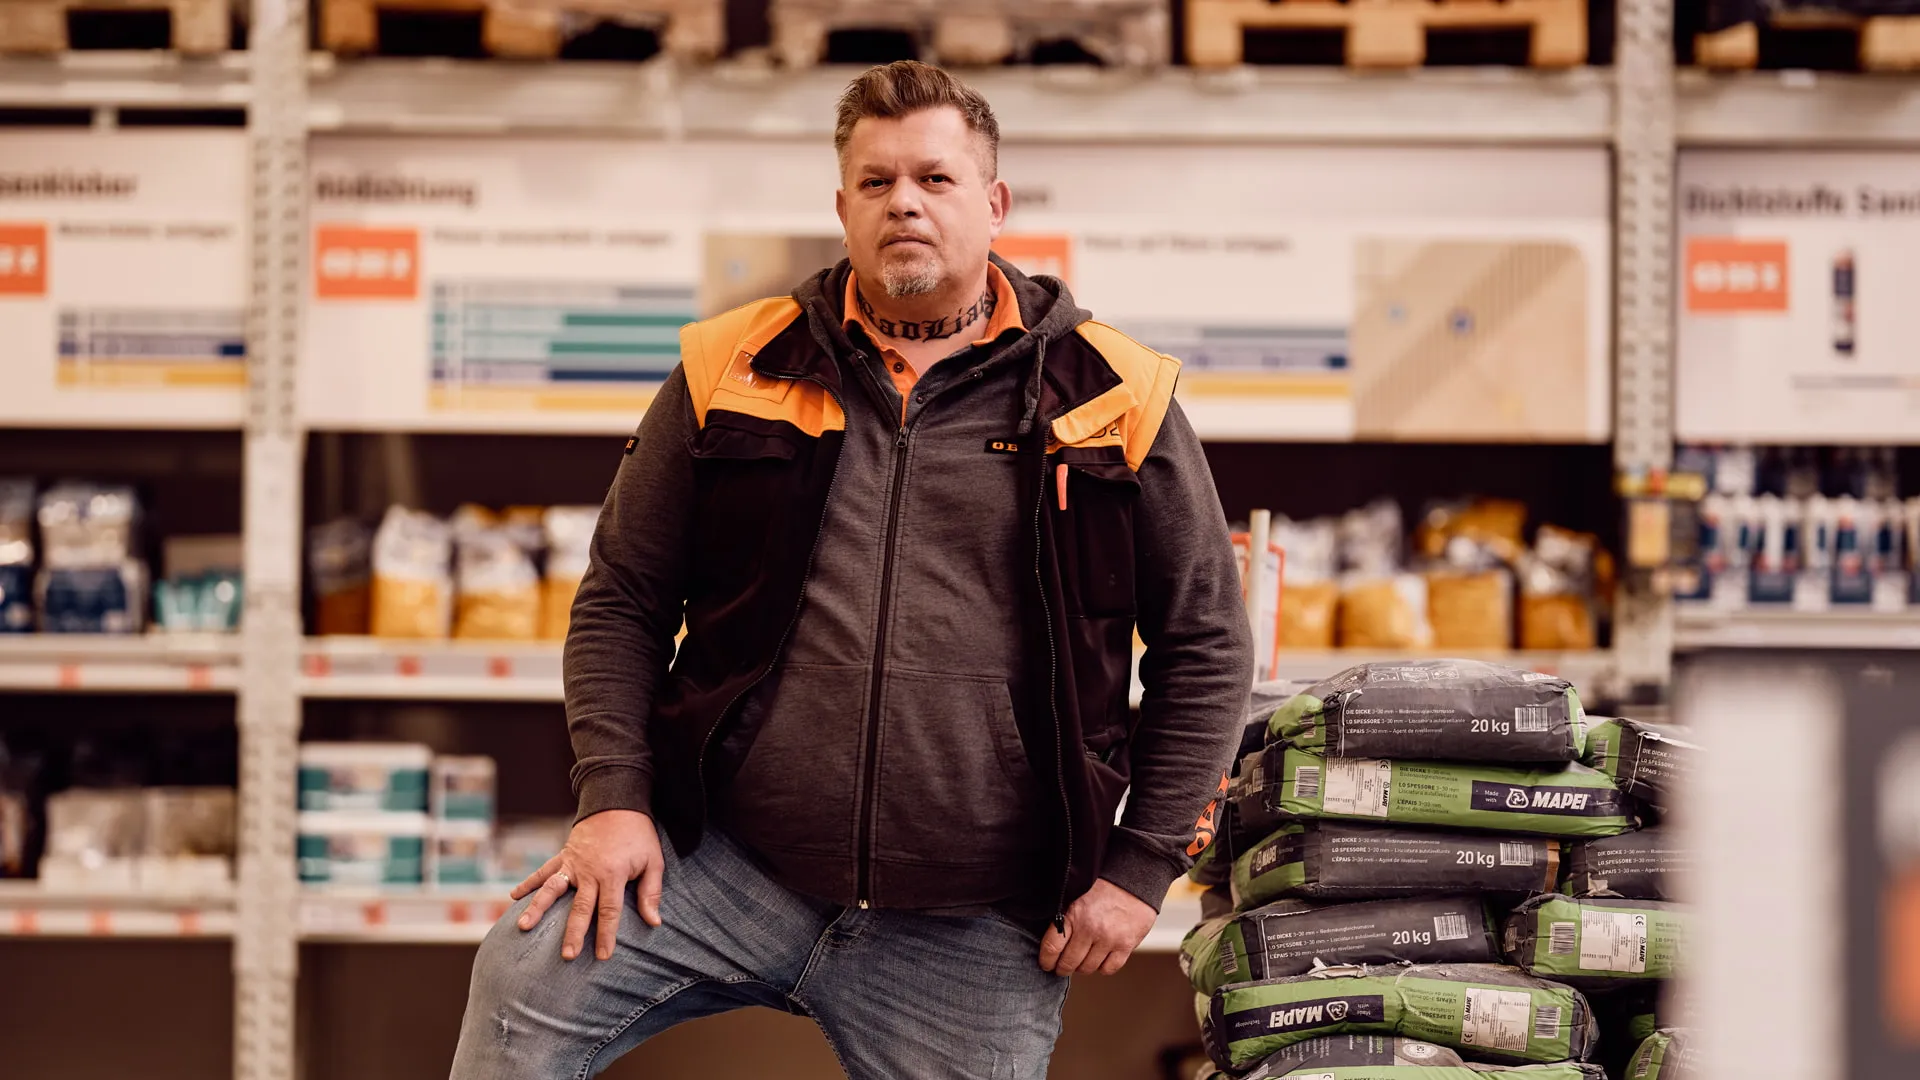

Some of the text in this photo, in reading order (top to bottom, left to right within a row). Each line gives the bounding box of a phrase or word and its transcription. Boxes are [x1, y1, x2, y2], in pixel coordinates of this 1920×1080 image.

[1470, 719, 1510, 735] 20 kg
[1531, 791, 1588, 810] MAPEI
[1456, 850, 1495, 868] 20 kg
[1392, 930, 1430, 945] 20 kg
[1235, 1019, 1260, 1028] Technology
[1269, 1005, 1323, 1028] MAPEI
